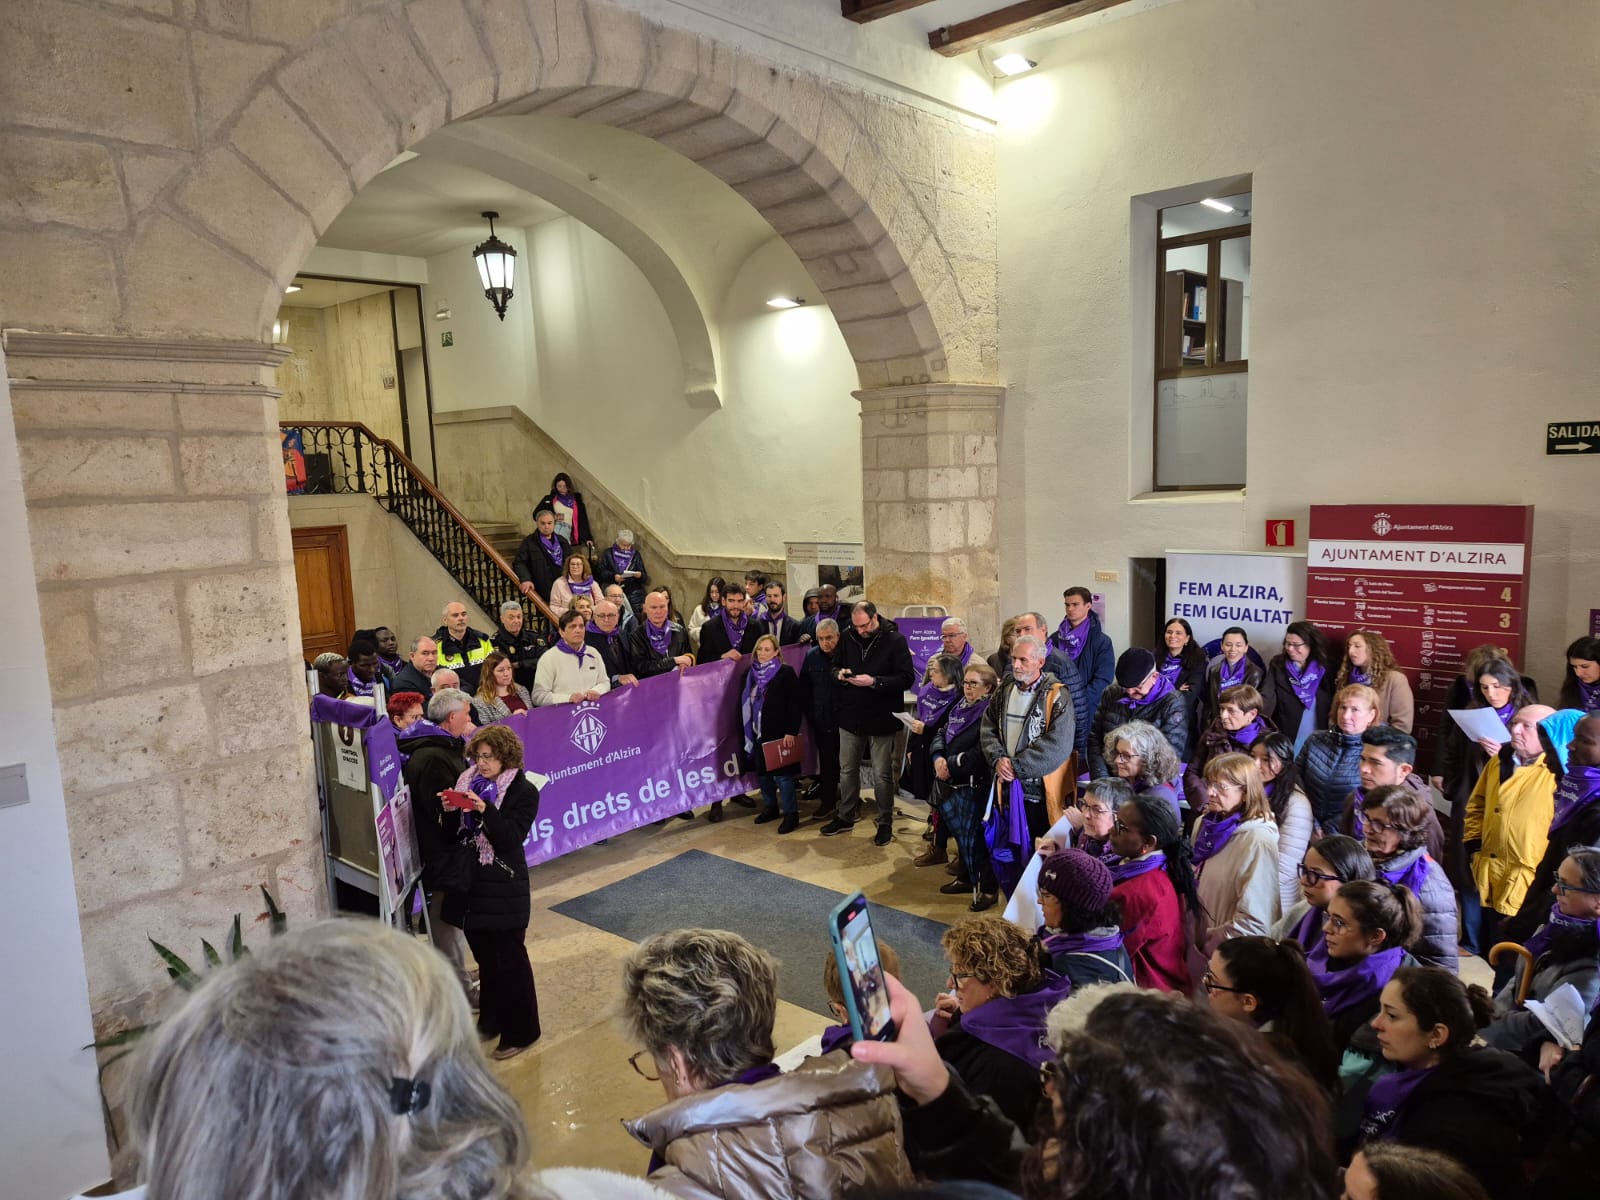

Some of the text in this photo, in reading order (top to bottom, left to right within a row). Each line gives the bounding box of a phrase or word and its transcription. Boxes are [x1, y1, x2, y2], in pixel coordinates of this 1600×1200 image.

[1549, 424, 1600, 439] SALIDA
[1393, 524, 1429, 532] Ajuntament
[1321, 547, 1425, 562] AJUNTAMENT
[1179, 581, 1284, 603] FEM ALZIRA,
[1500, 586, 1512, 602] 4
[1173, 603, 1293, 625] FEM IGUALTAT
[1499, 612, 1511, 628] 3
[605, 746, 641, 764] d'Alzira
[563, 791, 631, 830] drets
[639, 777, 671, 804] de
[677, 766, 717, 792] les
